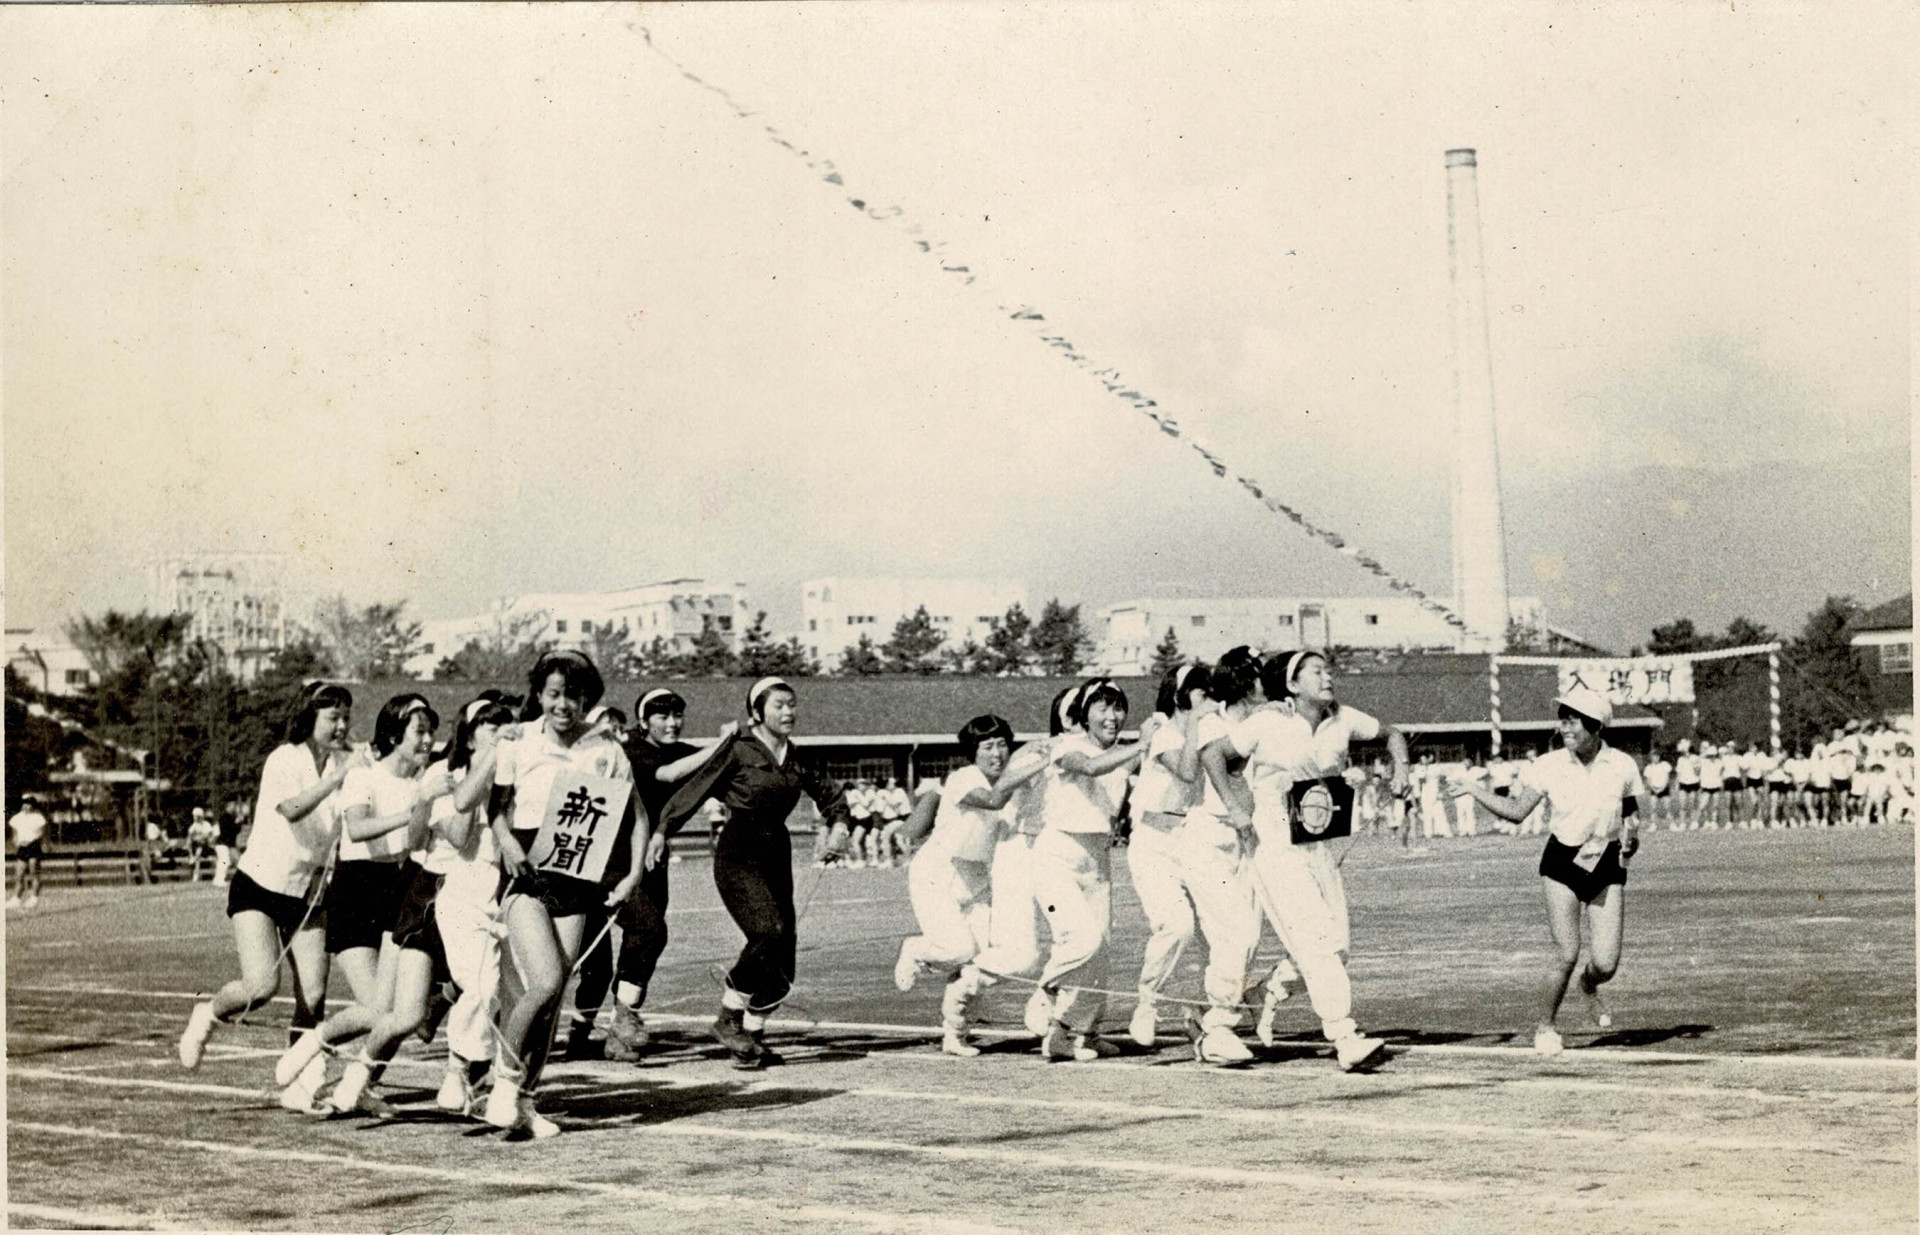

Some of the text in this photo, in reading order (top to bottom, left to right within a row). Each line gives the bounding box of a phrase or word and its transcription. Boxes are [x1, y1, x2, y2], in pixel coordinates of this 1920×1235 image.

[1567, 669, 1672, 698] 入場門
[538, 786, 608, 875] 新聞
